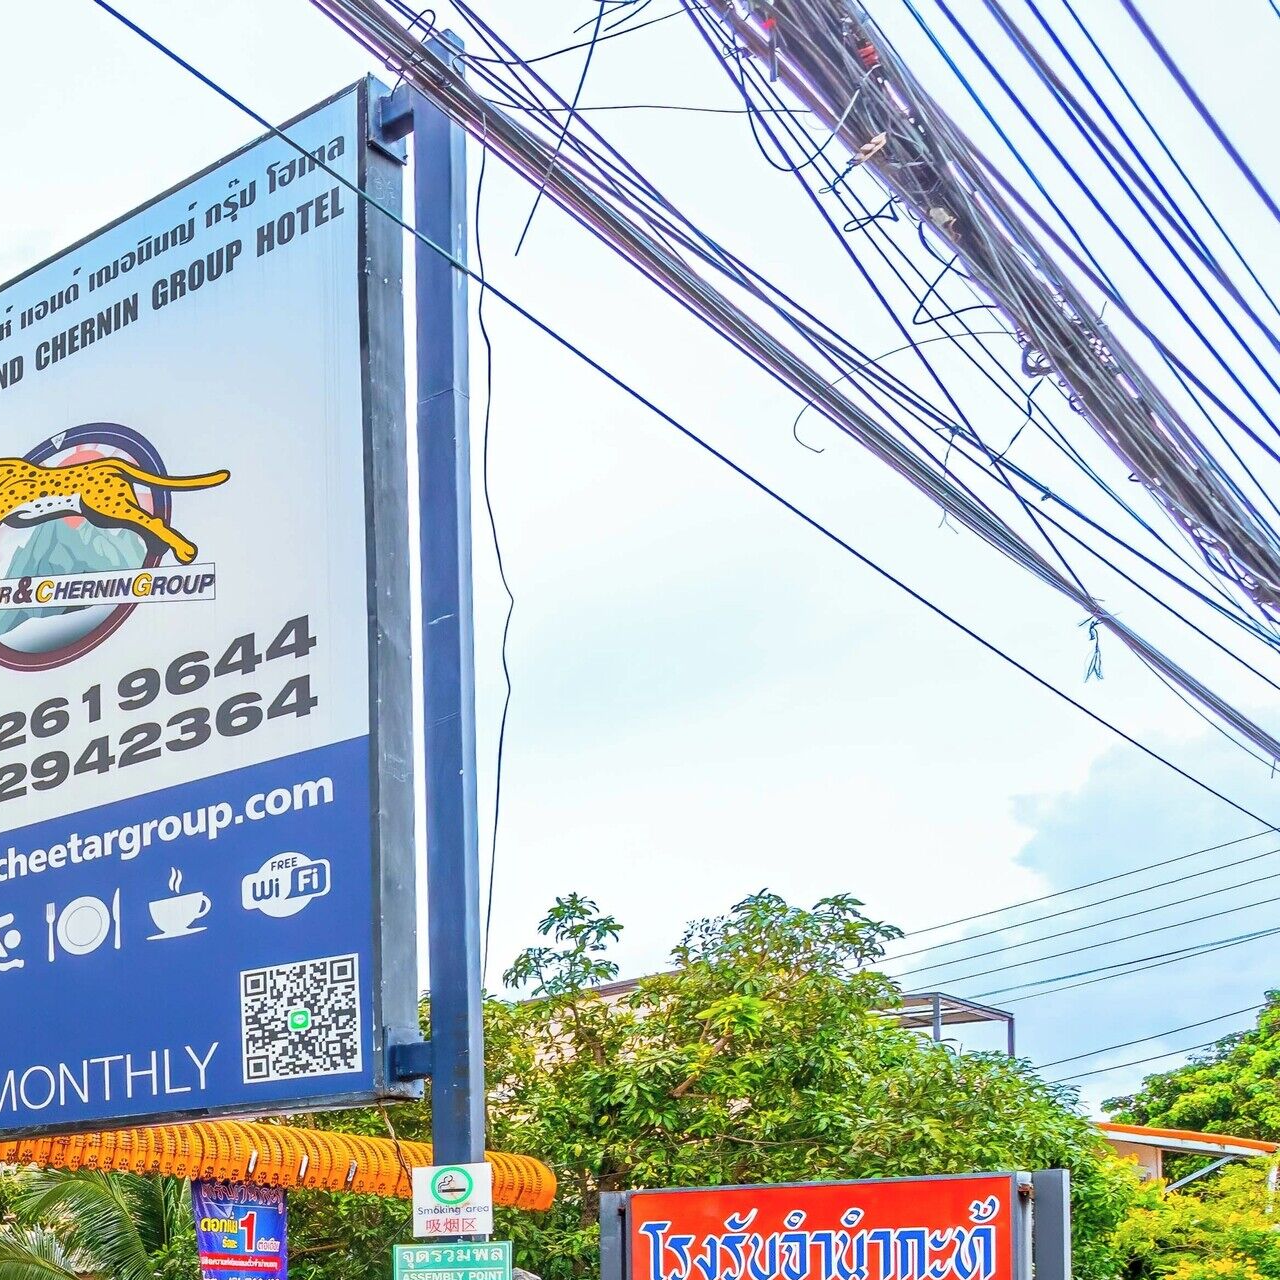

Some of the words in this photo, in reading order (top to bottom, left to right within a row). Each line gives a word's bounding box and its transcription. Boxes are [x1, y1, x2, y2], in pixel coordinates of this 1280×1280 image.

[20, 267, 82, 329] แอนด์
[205, 178, 257, 228] กรุ๊ป
[266, 135, 345, 194] โฮเทล
[35, 293, 138, 371] CHERNIN
[152, 239, 243, 311] GROUP
[256, 186, 345, 258] HOTEL
[271, 857, 298, 871] FREE
[417, 1205, 461, 1216] Smoking
[465, 1205, 490, 1213] area
[239, 1211, 257, 1252] 1
[426, 1217, 477, 1233] 吸烟区
[402, 1247, 504, 1269] จุดรวมพล
[468, 1271, 504, 1280] POINT
